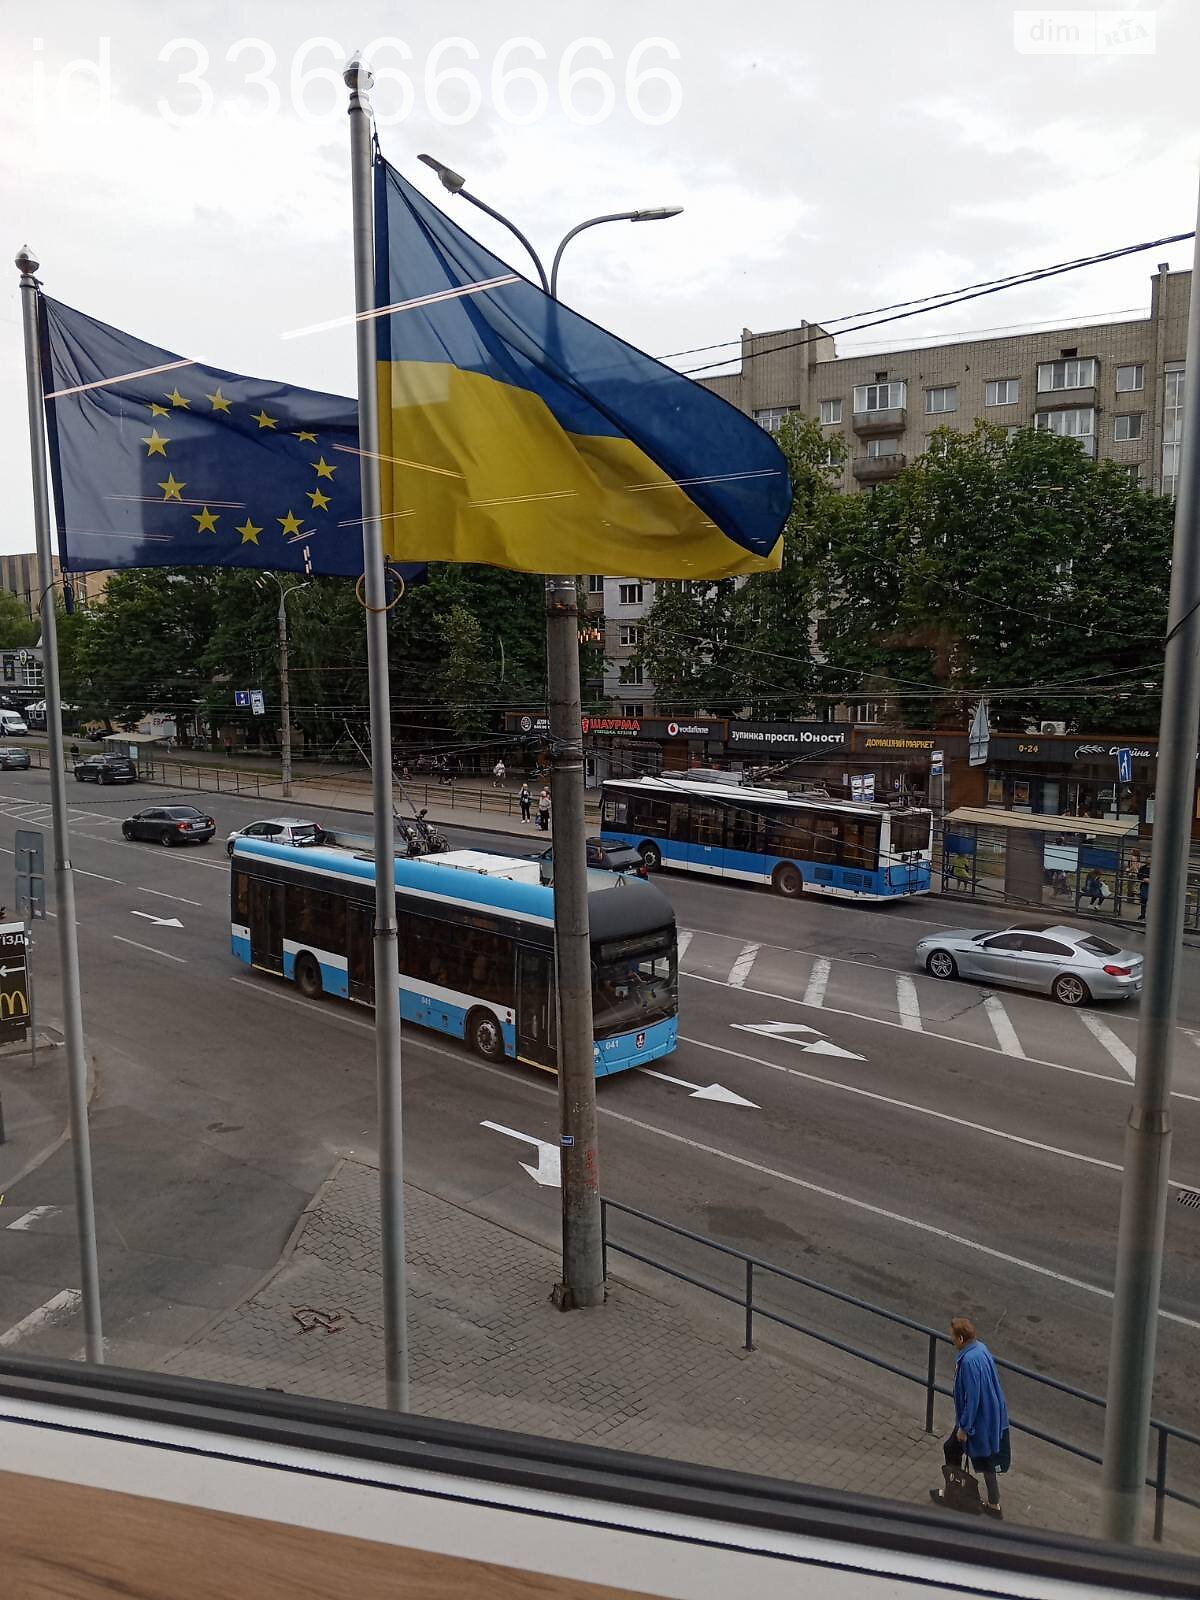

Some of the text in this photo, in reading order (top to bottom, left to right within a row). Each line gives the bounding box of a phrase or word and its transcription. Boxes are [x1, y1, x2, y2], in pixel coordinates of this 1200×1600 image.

[590, 718, 641, 730] ШАУРМА
[679, 725, 709, 734] vodafone
[765, 732, 798, 743] просп.
[800, 732, 845, 743] Юності
[905, 740, 935, 749] МАРКЕТ
[1018, 744, 1039, 753] 0-24
[605, 1039, 619, 1050] 041
